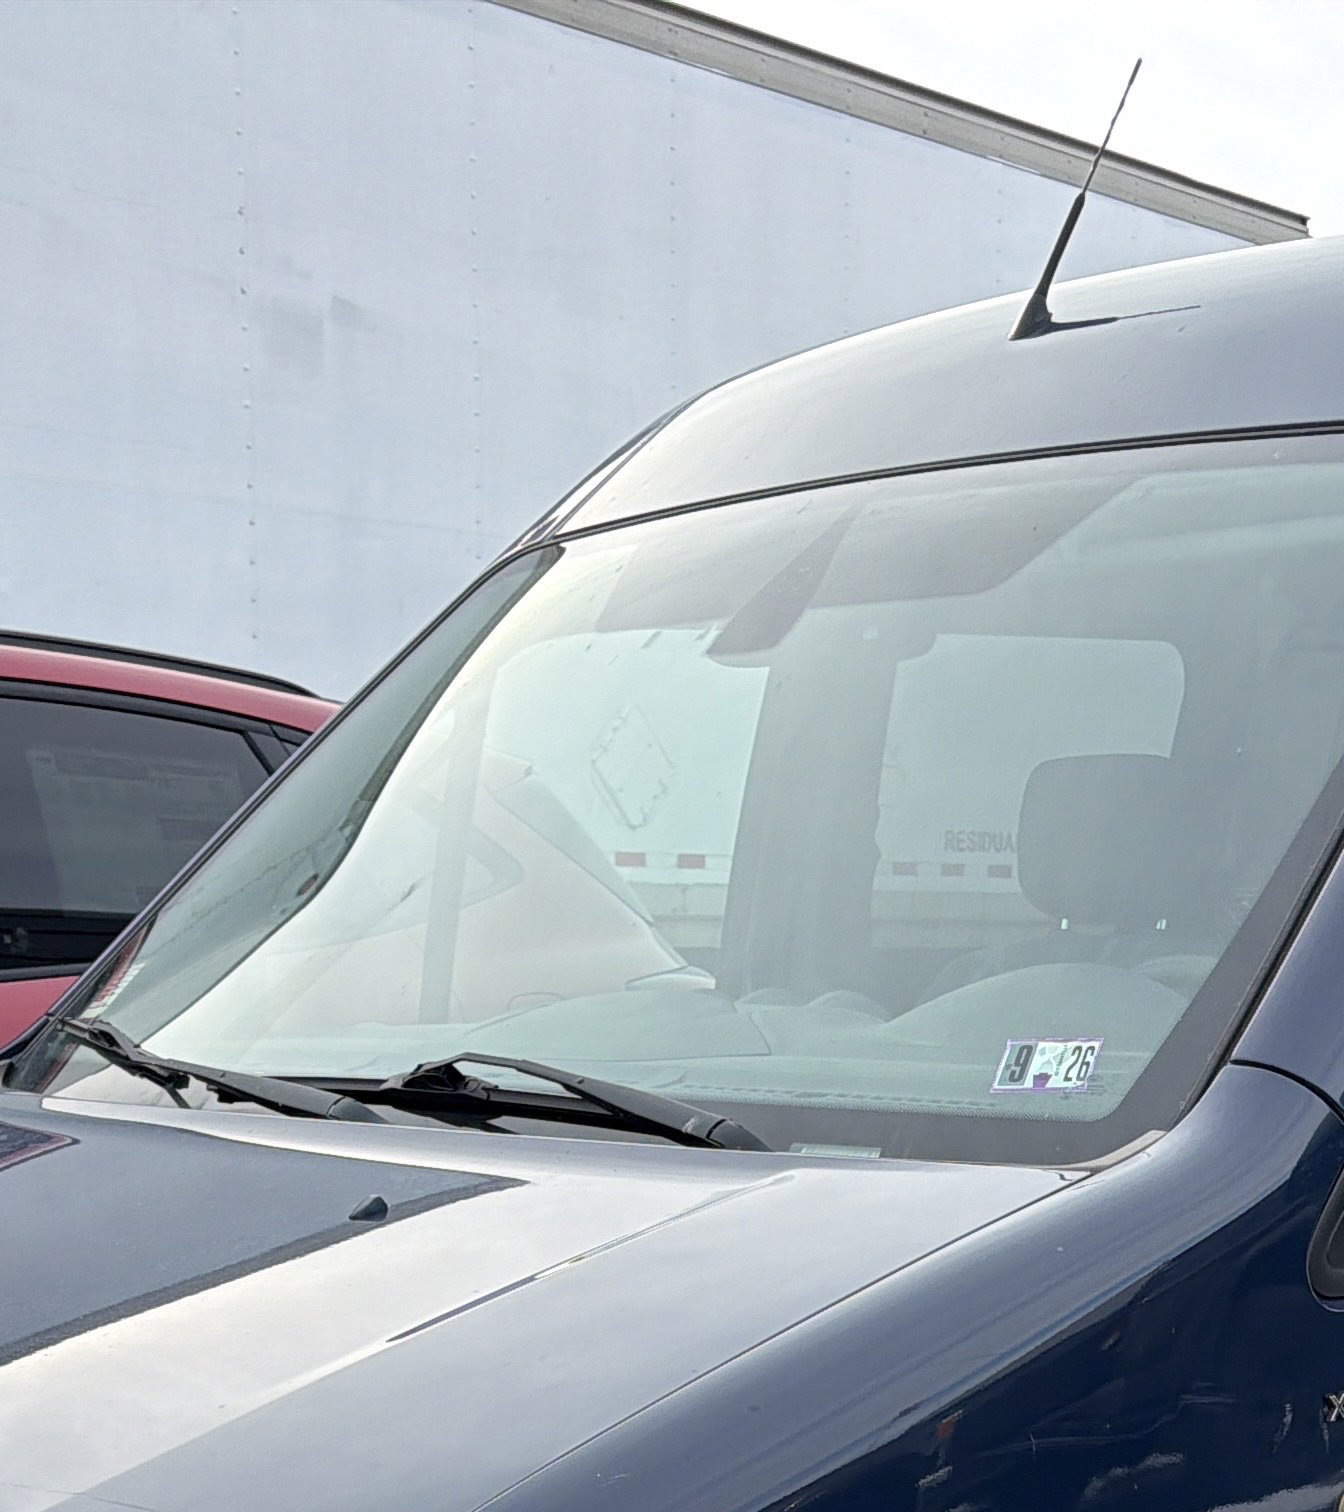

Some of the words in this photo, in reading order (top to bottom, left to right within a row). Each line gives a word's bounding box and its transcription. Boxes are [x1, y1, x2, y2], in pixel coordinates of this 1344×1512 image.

[943, 829, 1017, 854] RESIDUA
[1007, 1044, 1034, 1083] 9
[1062, 1045, 1096, 1082] 26
